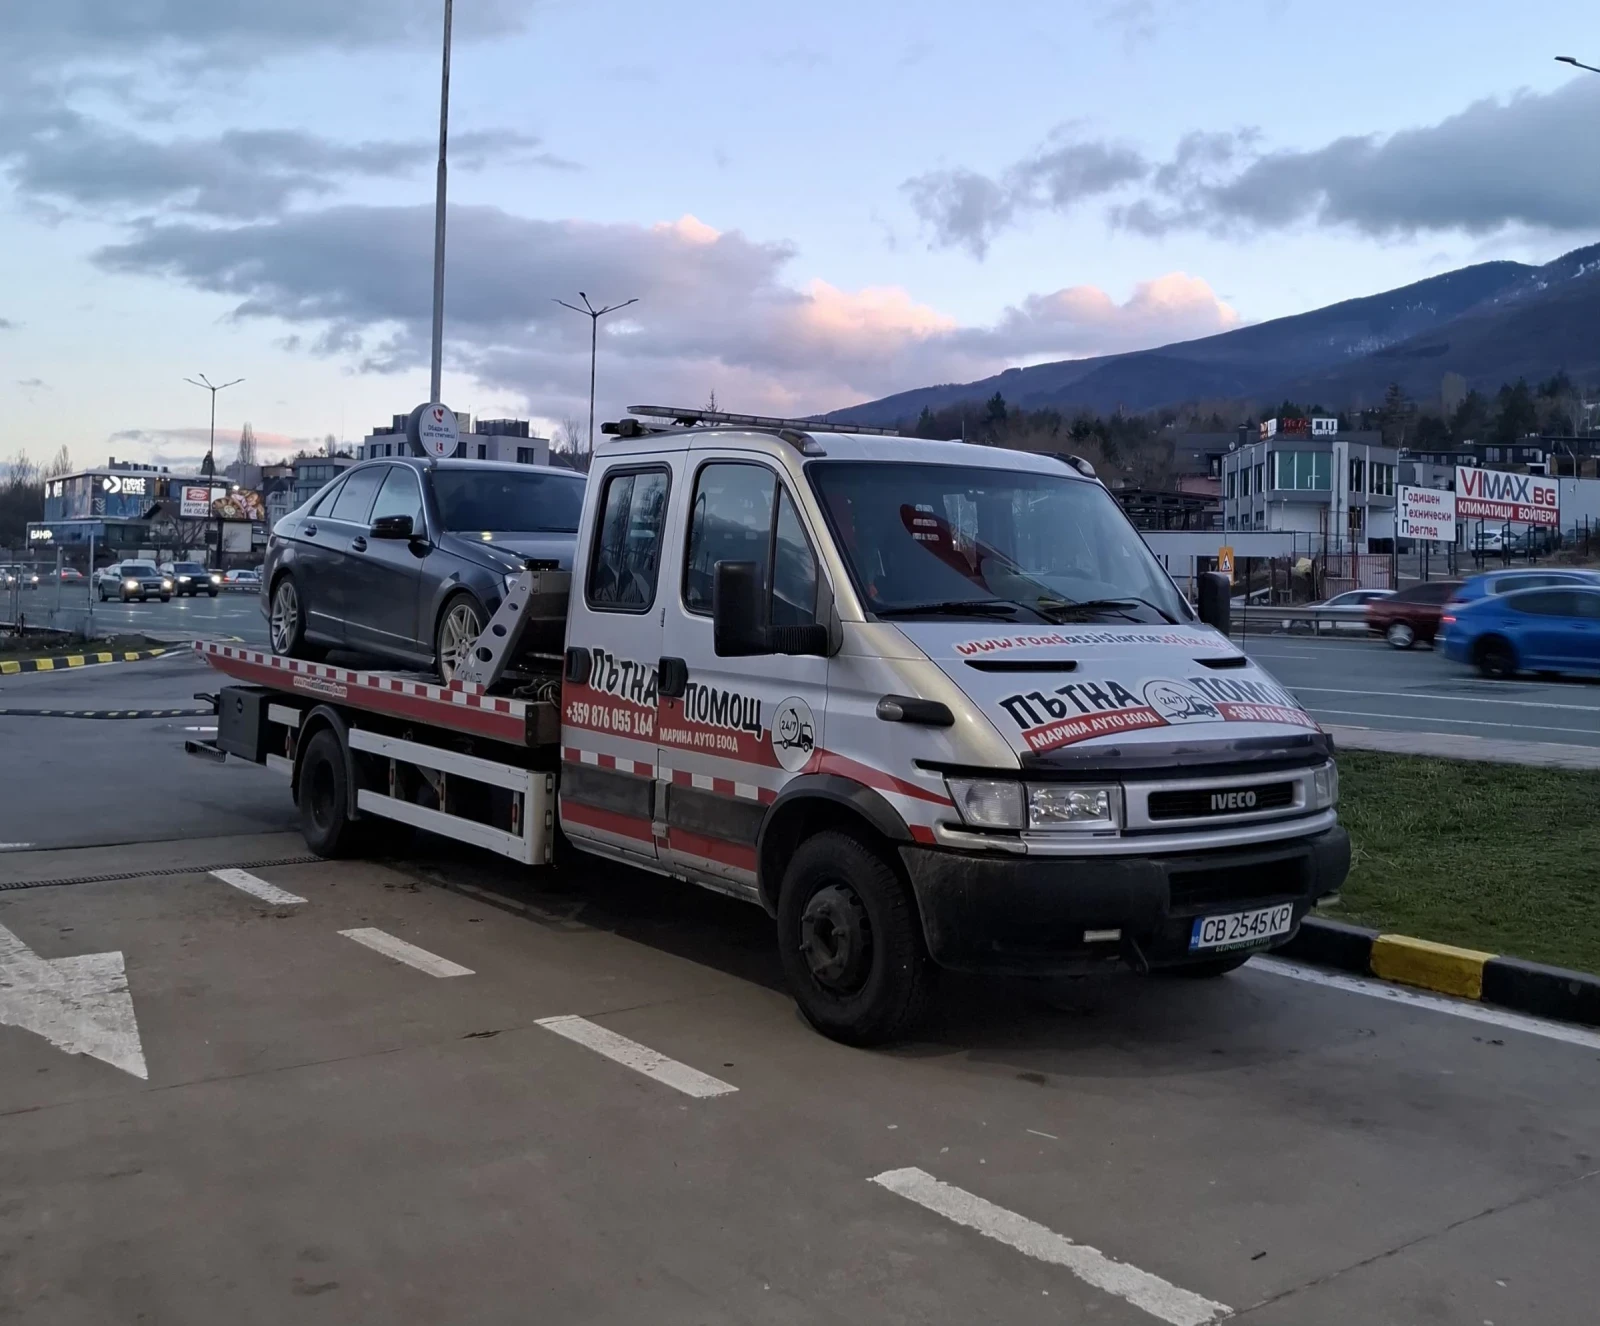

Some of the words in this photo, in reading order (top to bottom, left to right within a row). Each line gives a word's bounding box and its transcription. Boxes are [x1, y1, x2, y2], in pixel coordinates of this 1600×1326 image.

[1403, 487, 1440, 504] Годишен
[1460, 468, 1556, 506] VIMAX.BG
[1402, 503, 1452, 521] Технически
[1458, 501, 1513, 520] КЛИМАТИЦИ
[1518, 506, 1557, 523] БОЙЛЕРИ
[1402, 519, 1438, 537] Преглед
[590, 647, 659, 708] ПЪТНА
[685, 683, 763, 740] ПОМОЩ
[999, 681, 1145, 730] ПЪТНА
[1160, 695, 1185, 706] 24/7
[1228, 705, 1260, 720] +359
[566, 701, 589, 725] +359
[592, 705, 610, 728] 876
[612, 708, 631, 733] 055
[634, 711, 653, 737] 164
[781, 720, 798, 732] 24/7
[1029, 720, 1090, 749] МАРИНА
[1092, 714, 1125, 732] АУТО
[1126, 710, 1159, 725] ЕООД
[660, 727, 692, 745] МАРИНА
[694, 731, 716, 749] АУТО
[717, 734, 738, 753] ЕООД
[1211, 790, 1257, 811] IVECO
[1229, 912, 1269, 940] 2545
